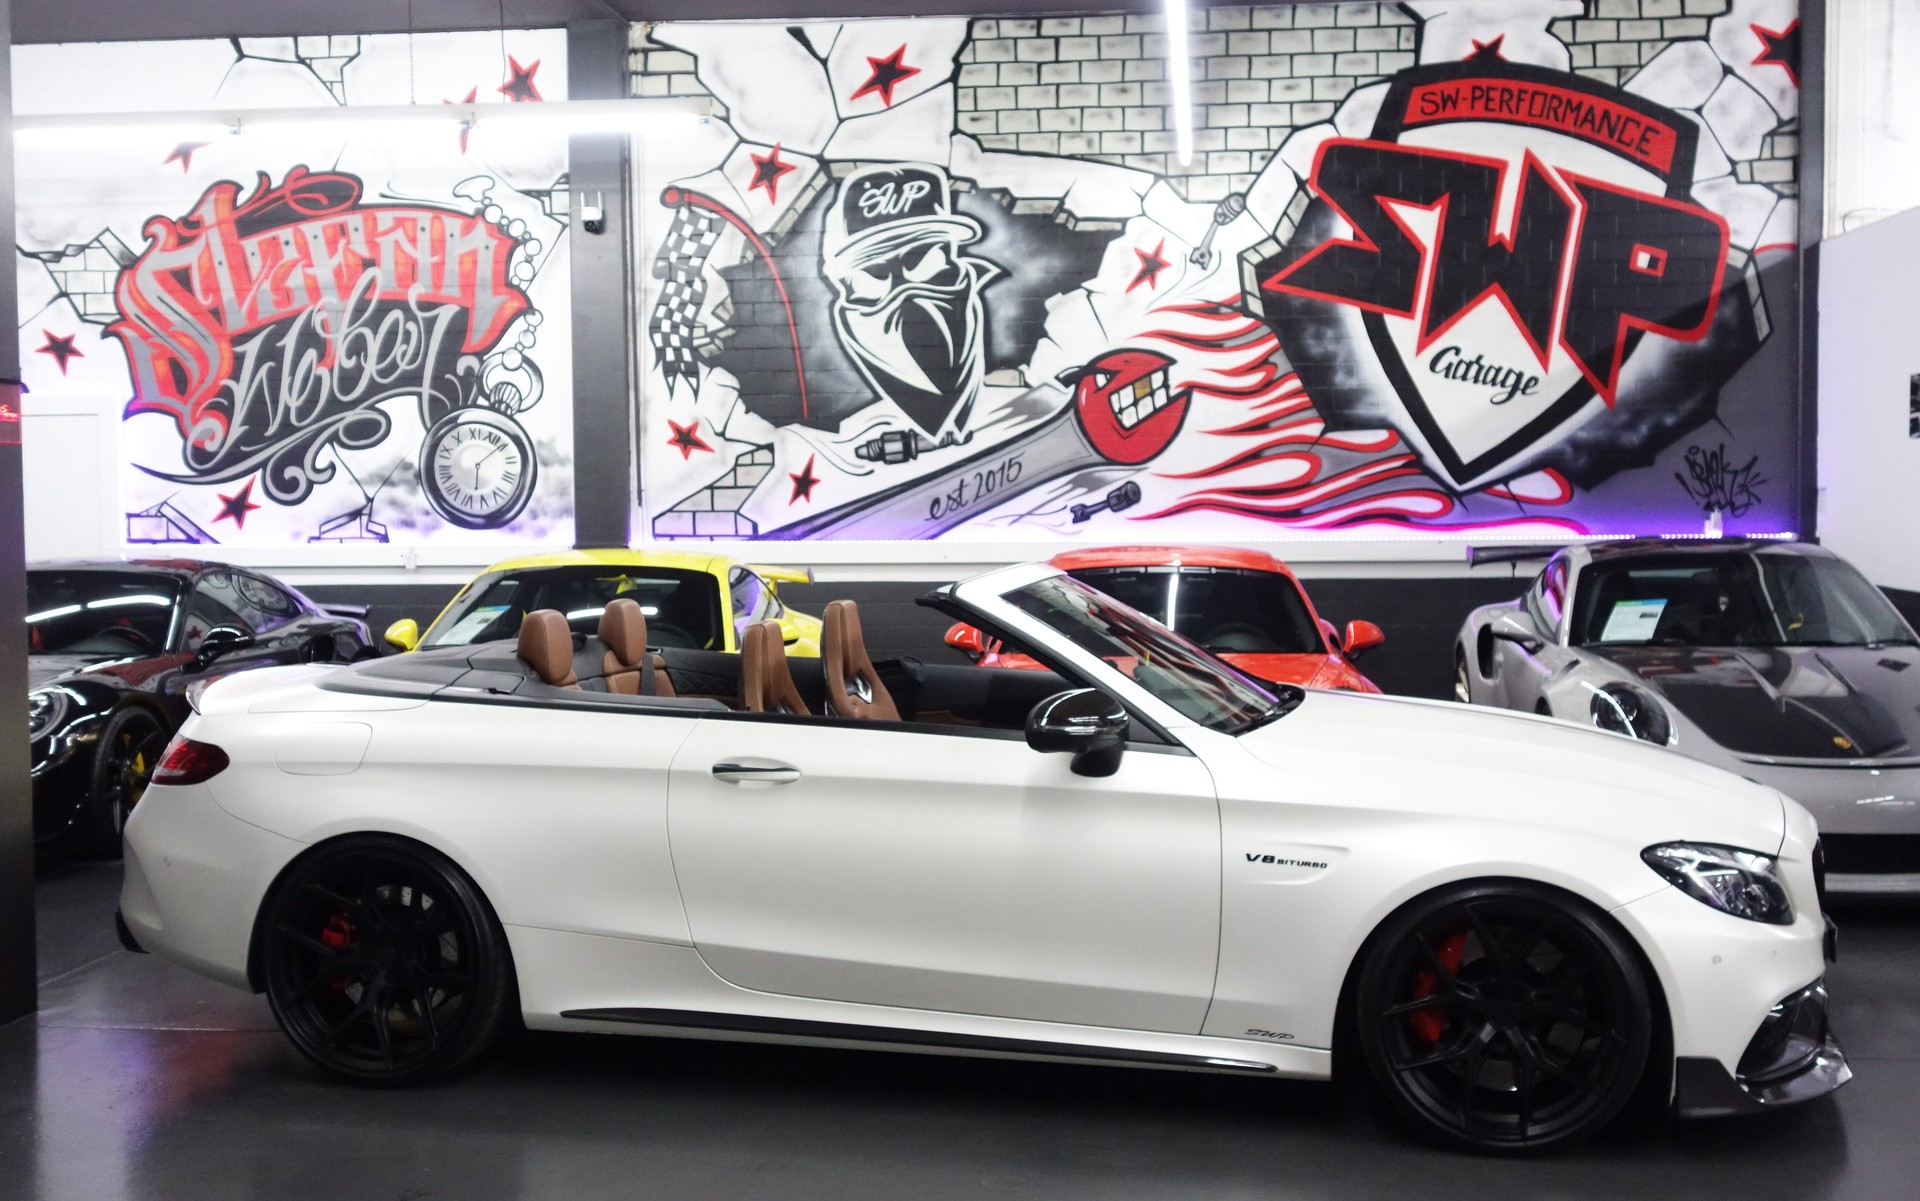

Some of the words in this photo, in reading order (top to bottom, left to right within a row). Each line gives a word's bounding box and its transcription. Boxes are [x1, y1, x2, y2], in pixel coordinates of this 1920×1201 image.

[1420, 85, 1661, 156] SW-PERFORMANCE
[859, 180, 931, 218] SWP
[1262, 138, 1731, 409] SWP
[1429, 345, 1540, 405] Garage
[925, 478, 970, 521] est
[973, 451, 1026, 503] 2015
[1245, 853, 1276, 864] V8
[1277, 858, 1328, 869] BITURBO
[1244, 1029, 1295, 1040] SWP
